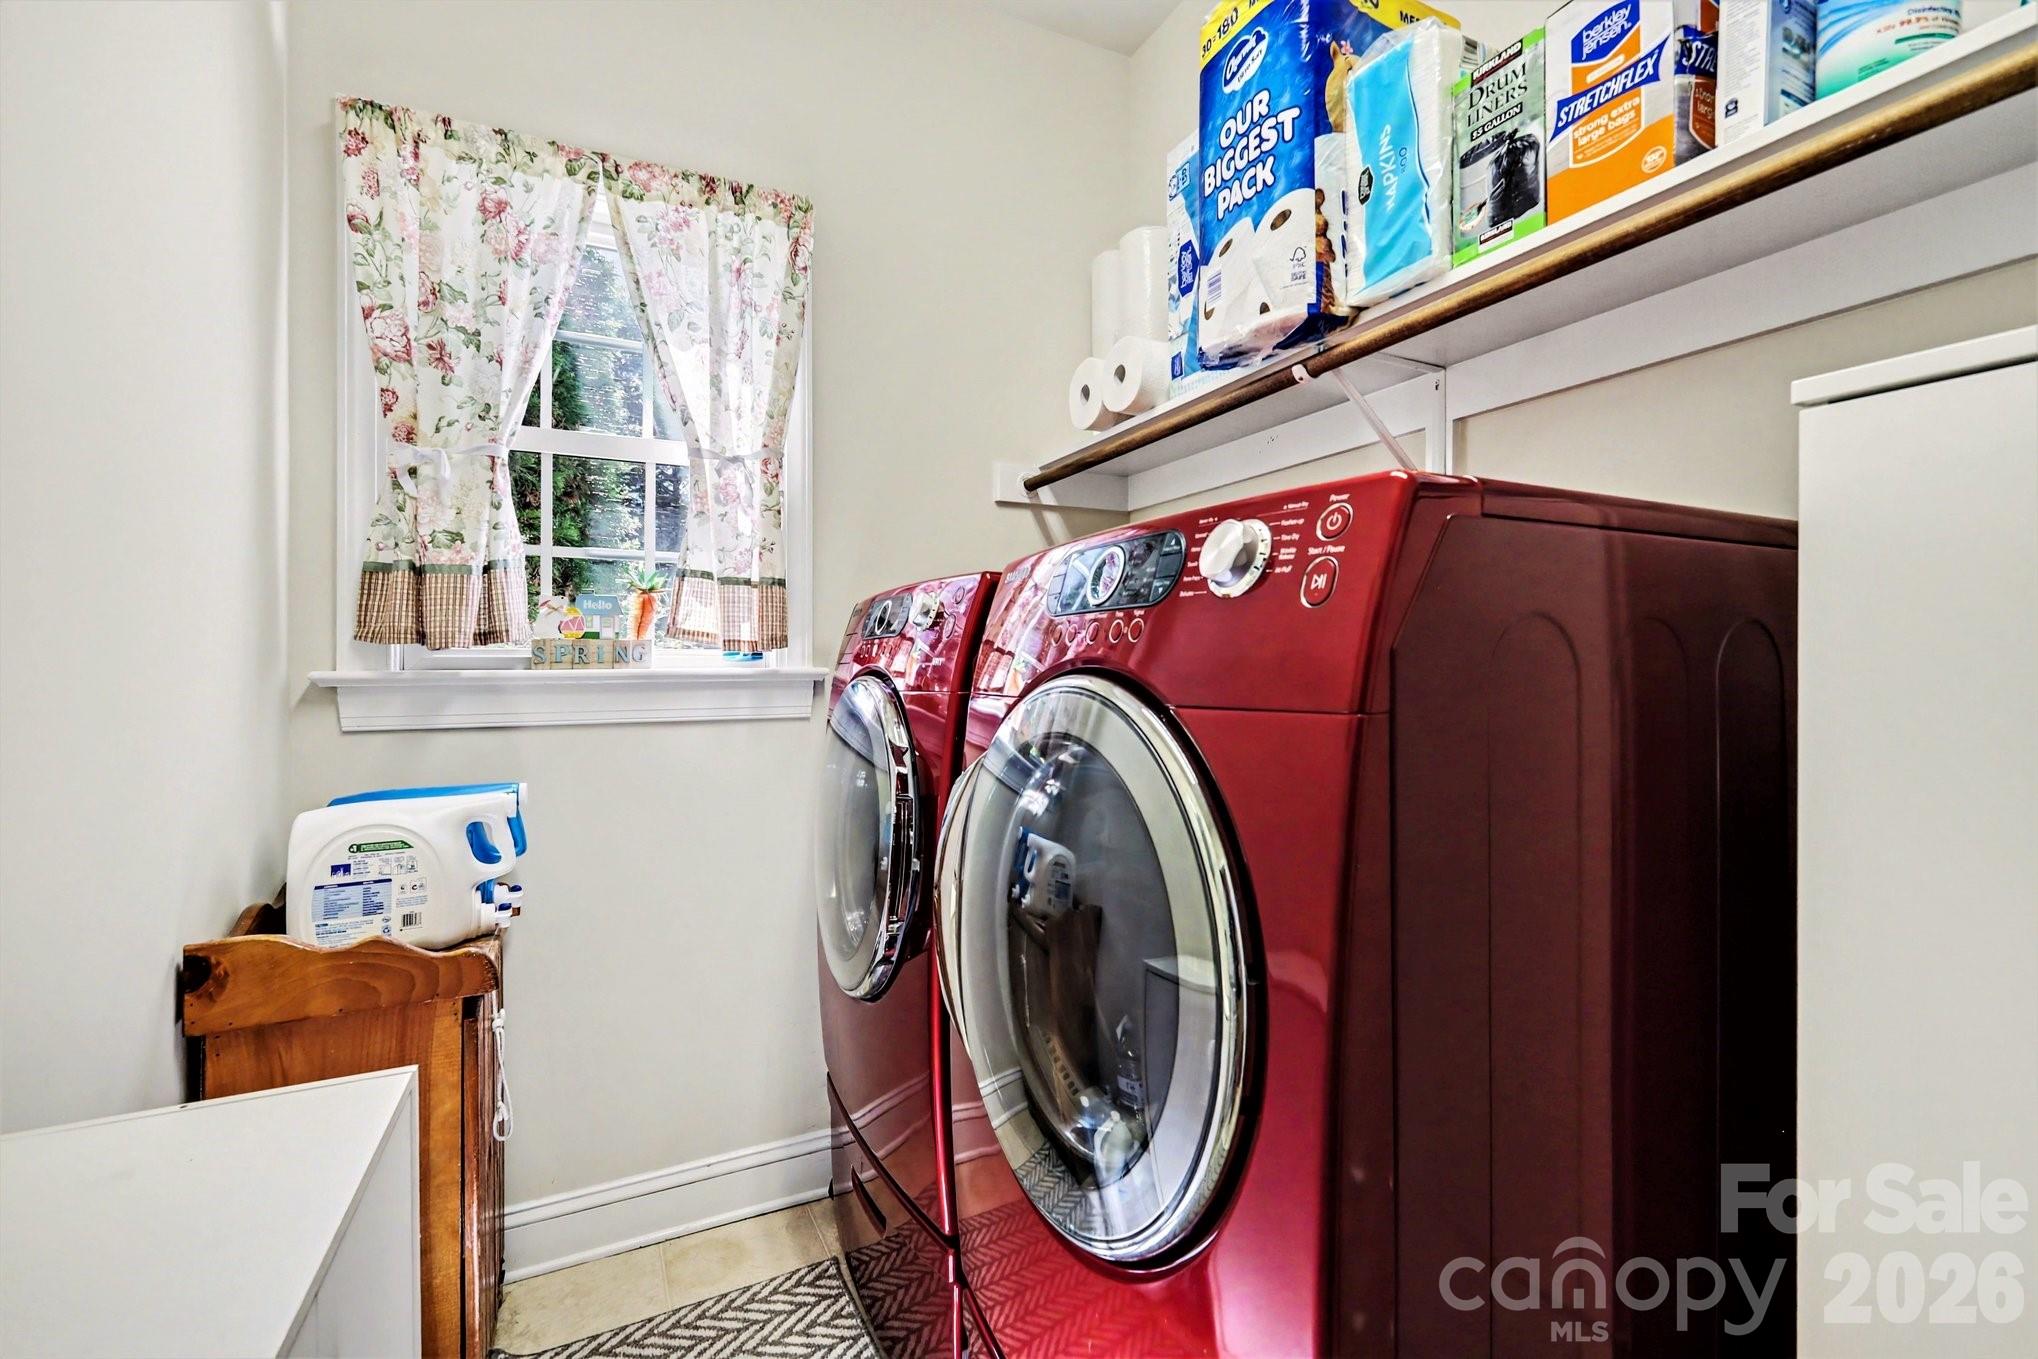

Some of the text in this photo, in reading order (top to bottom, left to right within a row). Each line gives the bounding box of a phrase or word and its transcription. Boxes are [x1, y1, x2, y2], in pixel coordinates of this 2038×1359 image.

[1582, 3, 1631, 41] berkley
[1472, 41, 1522, 80] KIRKLAND
[1468, 80, 1528, 127] LINERS
[1469, 62, 1526, 109] DRUM
[1557, 49, 1660, 128] STRETCHFLEX
[1220, 89, 1270, 148] OUR
[1484, 104, 1521, 132] GALLON
[1573, 96, 1640, 139] strong extra
[1608, 110, 1637, 131] bags
[1204, 107, 1301, 197] BIGGEST
[1217, 155, 1275, 220] PACK
[583, 599, 612, 610] Hello
[532, 645, 646, 665] SPRING
